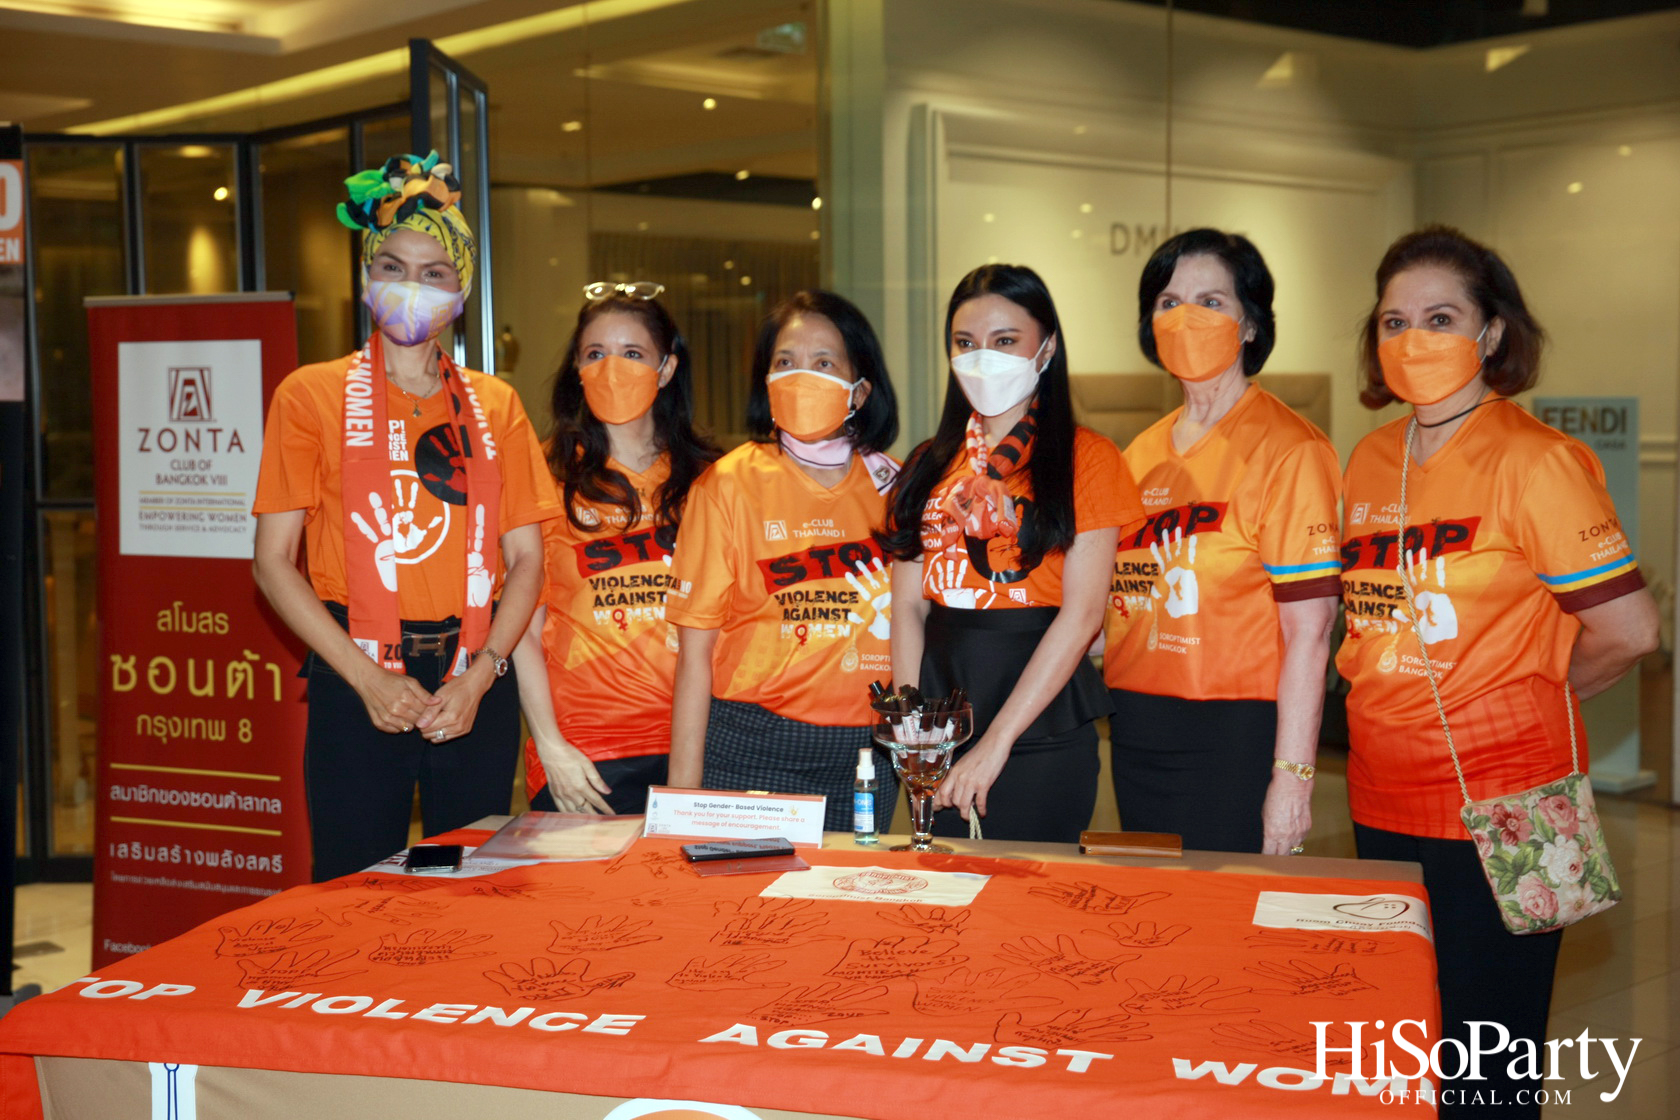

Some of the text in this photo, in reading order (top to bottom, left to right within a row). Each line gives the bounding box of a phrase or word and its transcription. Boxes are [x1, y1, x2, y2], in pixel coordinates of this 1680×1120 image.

[345, 362, 374, 447] WOMEN
[1542, 406, 1629, 434] FENDI
[138, 428, 245, 453] ZONTA
[170, 459, 212, 471] CLUB OF
[155, 473, 228, 486] BANGKOK VIII
[1144, 488, 1169, 496] e-CLUB
[138, 511, 247, 522] EMPOWERING WOMEN
[803, 519, 834, 528] e-CLUB
[793, 529, 840, 537] THAILAND
[774, 590, 859, 606] VIOLENCE
[157, 601, 229, 634] สโมสร
[783, 607, 851, 622] AGAINST
[781, 624, 850, 639] WOMEN
[1160, 632, 1200, 645] SOROPTIMIST
[110, 649, 281, 702] ซอนต้า
[137, 714, 253, 744] กรุงเทพ 8
[694, 802, 707, 810] Stop
[691, 820, 720, 828] message
[728, 822, 780, 830] encouragement.
[860, 949, 929, 957] Believe
[237, 990, 646, 1035] VIOLENCE
[697, 1023, 1114, 1073] AGAINST
